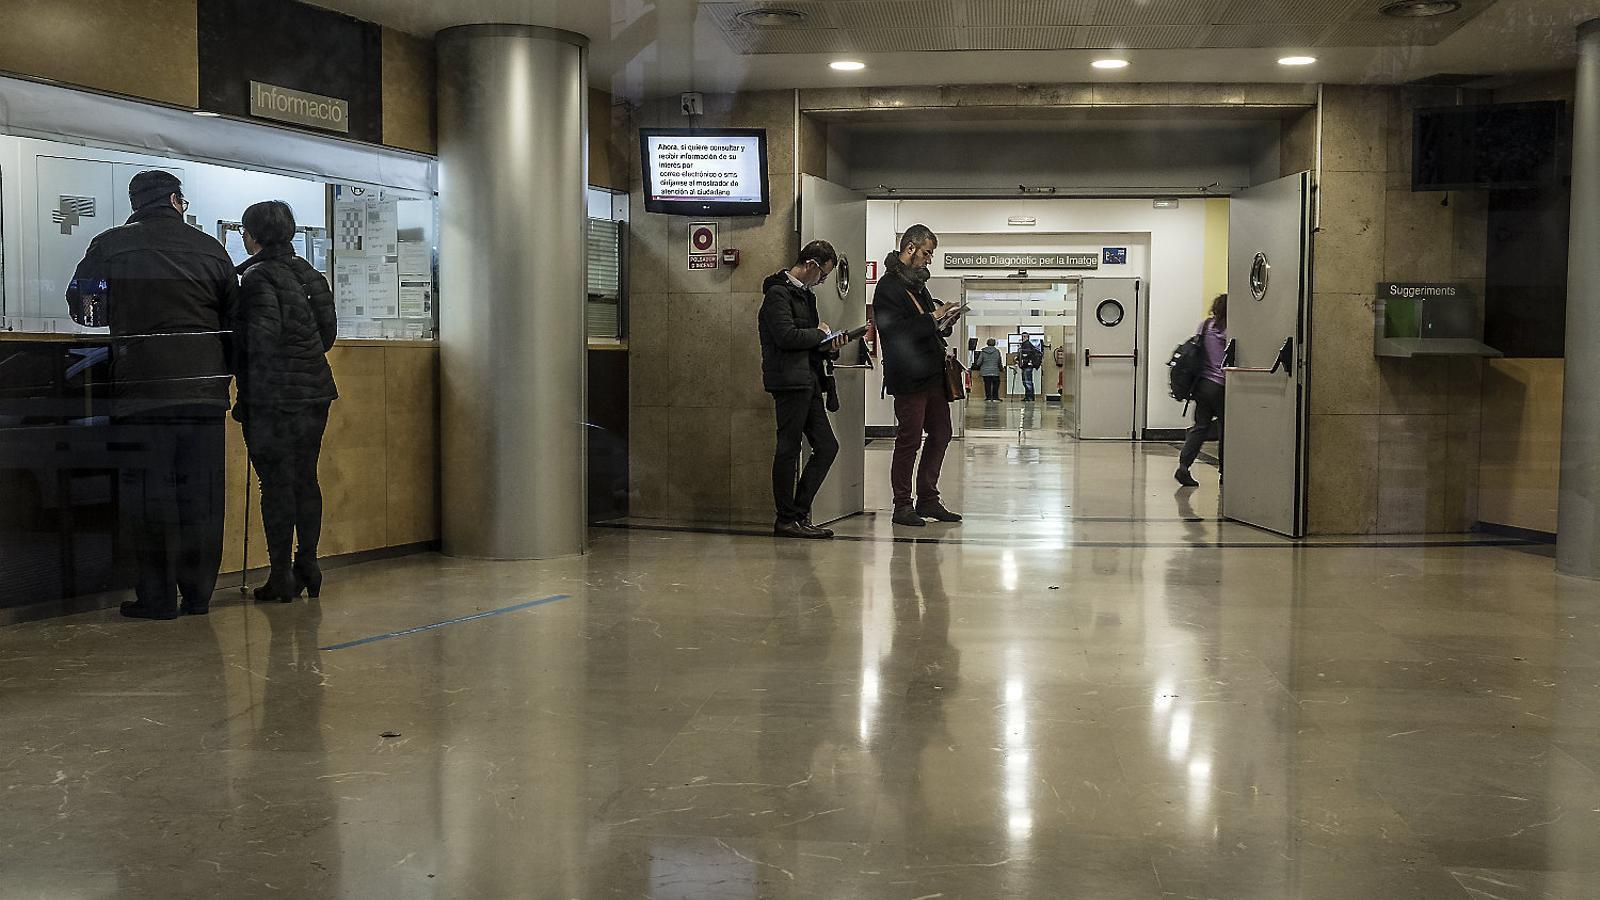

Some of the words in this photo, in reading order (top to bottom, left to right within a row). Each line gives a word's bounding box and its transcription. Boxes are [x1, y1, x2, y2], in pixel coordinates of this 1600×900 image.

[257, 85, 342, 122] Informació
[658, 143, 679, 152] Ahora,
[680, 143, 687, 151] si
[687, 143, 709, 153] quiere
[709, 143, 740, 152] consultar
[740, 145, 746, 153] y
[658, 152, 679, 160] recibir
[680, 152, 718, 160] información
[682, 162, 693, 170] por
[681, 170, 717, 178] electrónico
[696, 188, 731, 196] ciudadano
[945, 255, 974, 265] Servei
[975, 255, 988, 265] de
[1039, 257, 1055, 267] per
[1056, 255, 1066, 265] la
[1066, 255, 1098, 267] Imatge
[1390, 284, 1456, 298] Suggeriments
